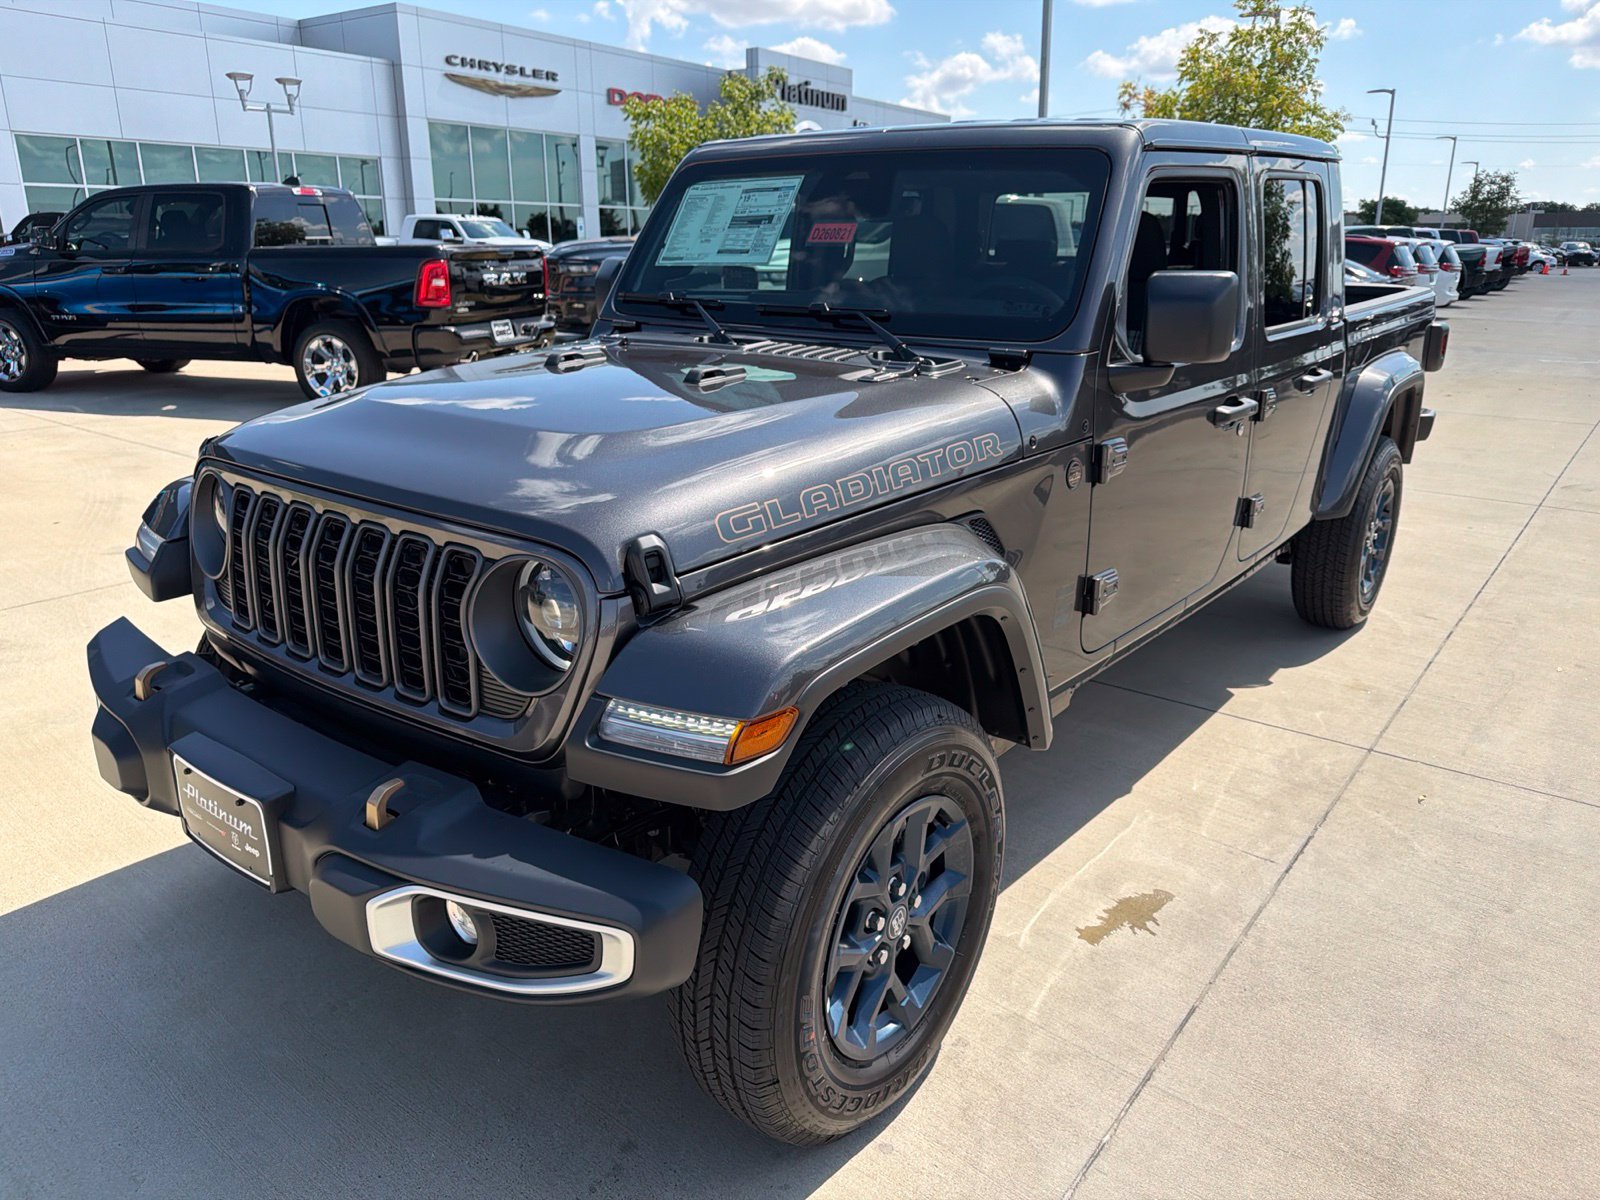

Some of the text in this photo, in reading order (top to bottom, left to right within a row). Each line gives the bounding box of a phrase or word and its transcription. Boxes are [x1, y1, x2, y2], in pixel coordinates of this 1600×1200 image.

[444, 54, 560, 82] CHRYSLER
[715, 432, 1003, 544] GLADIATOR
[183, 783, 258, 841] Platinum
